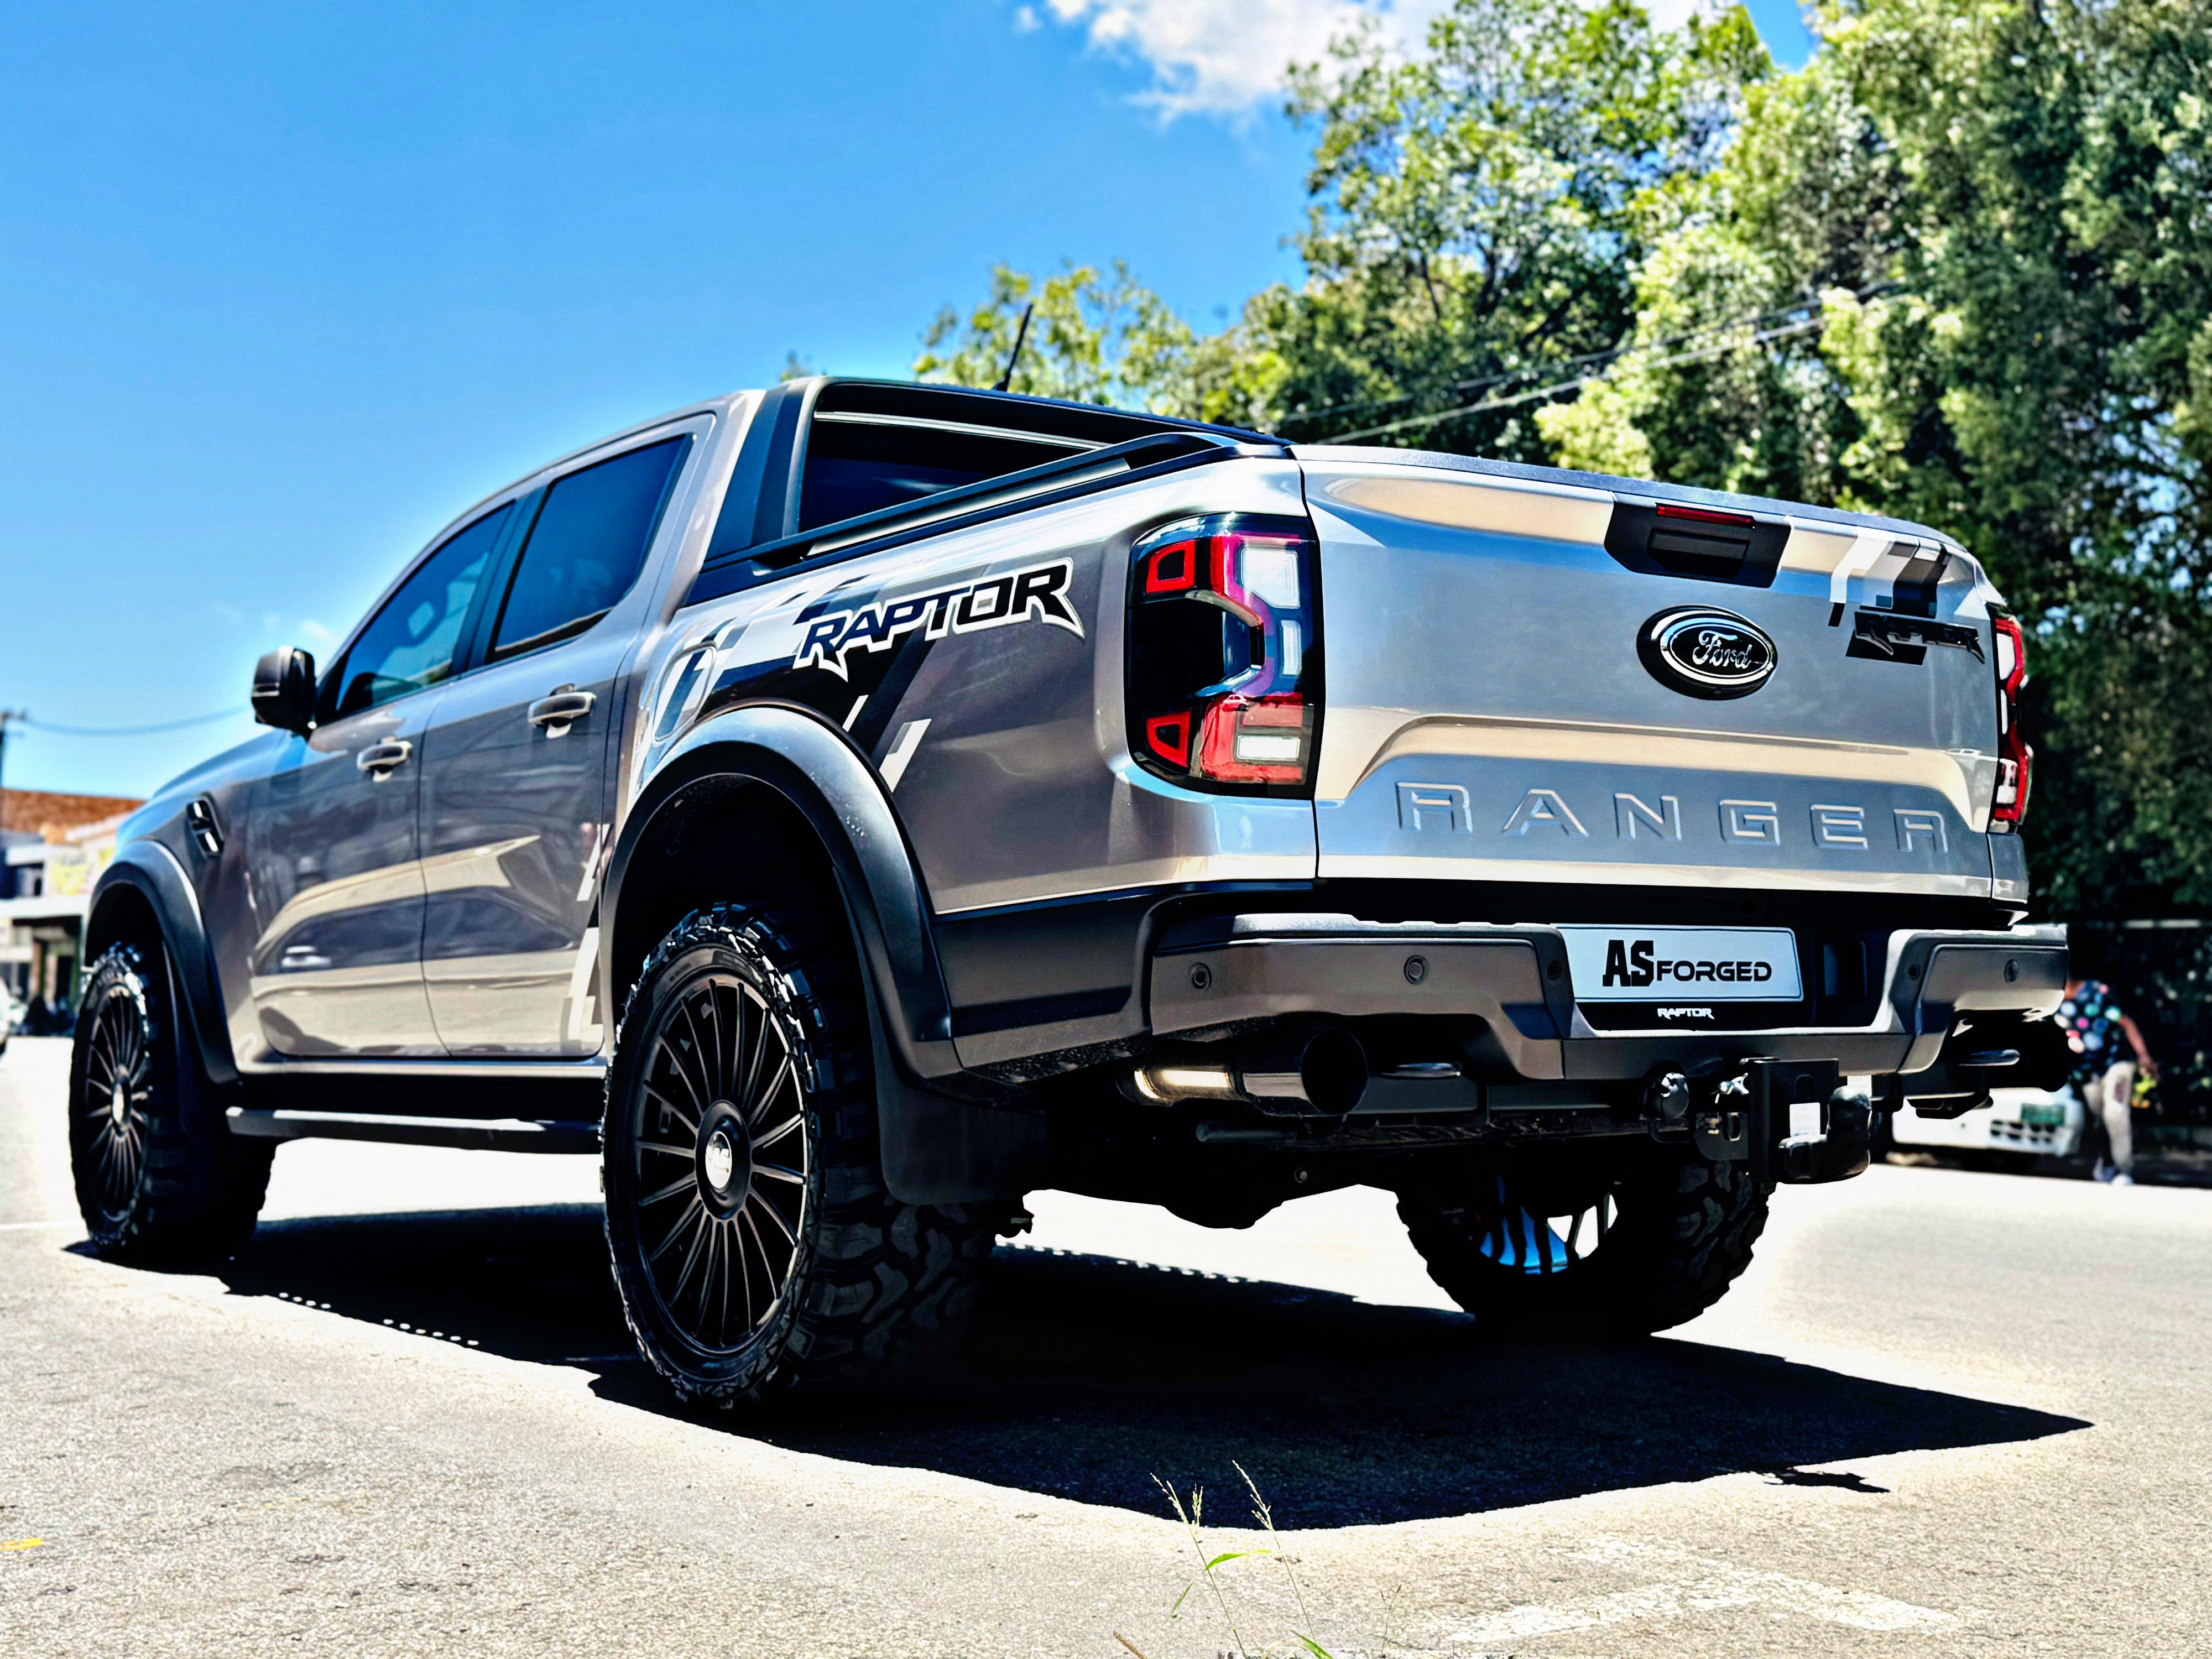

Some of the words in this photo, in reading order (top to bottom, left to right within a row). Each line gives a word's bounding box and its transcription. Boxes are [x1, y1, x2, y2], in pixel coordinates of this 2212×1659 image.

[793, 558, 1084, 682] RAPTOR
[1692, 630, 1752, 669] Ford
[1395, 781, 1949, 853] RANGER
[1657, 1008, 1715, 1020] RAPTOR
